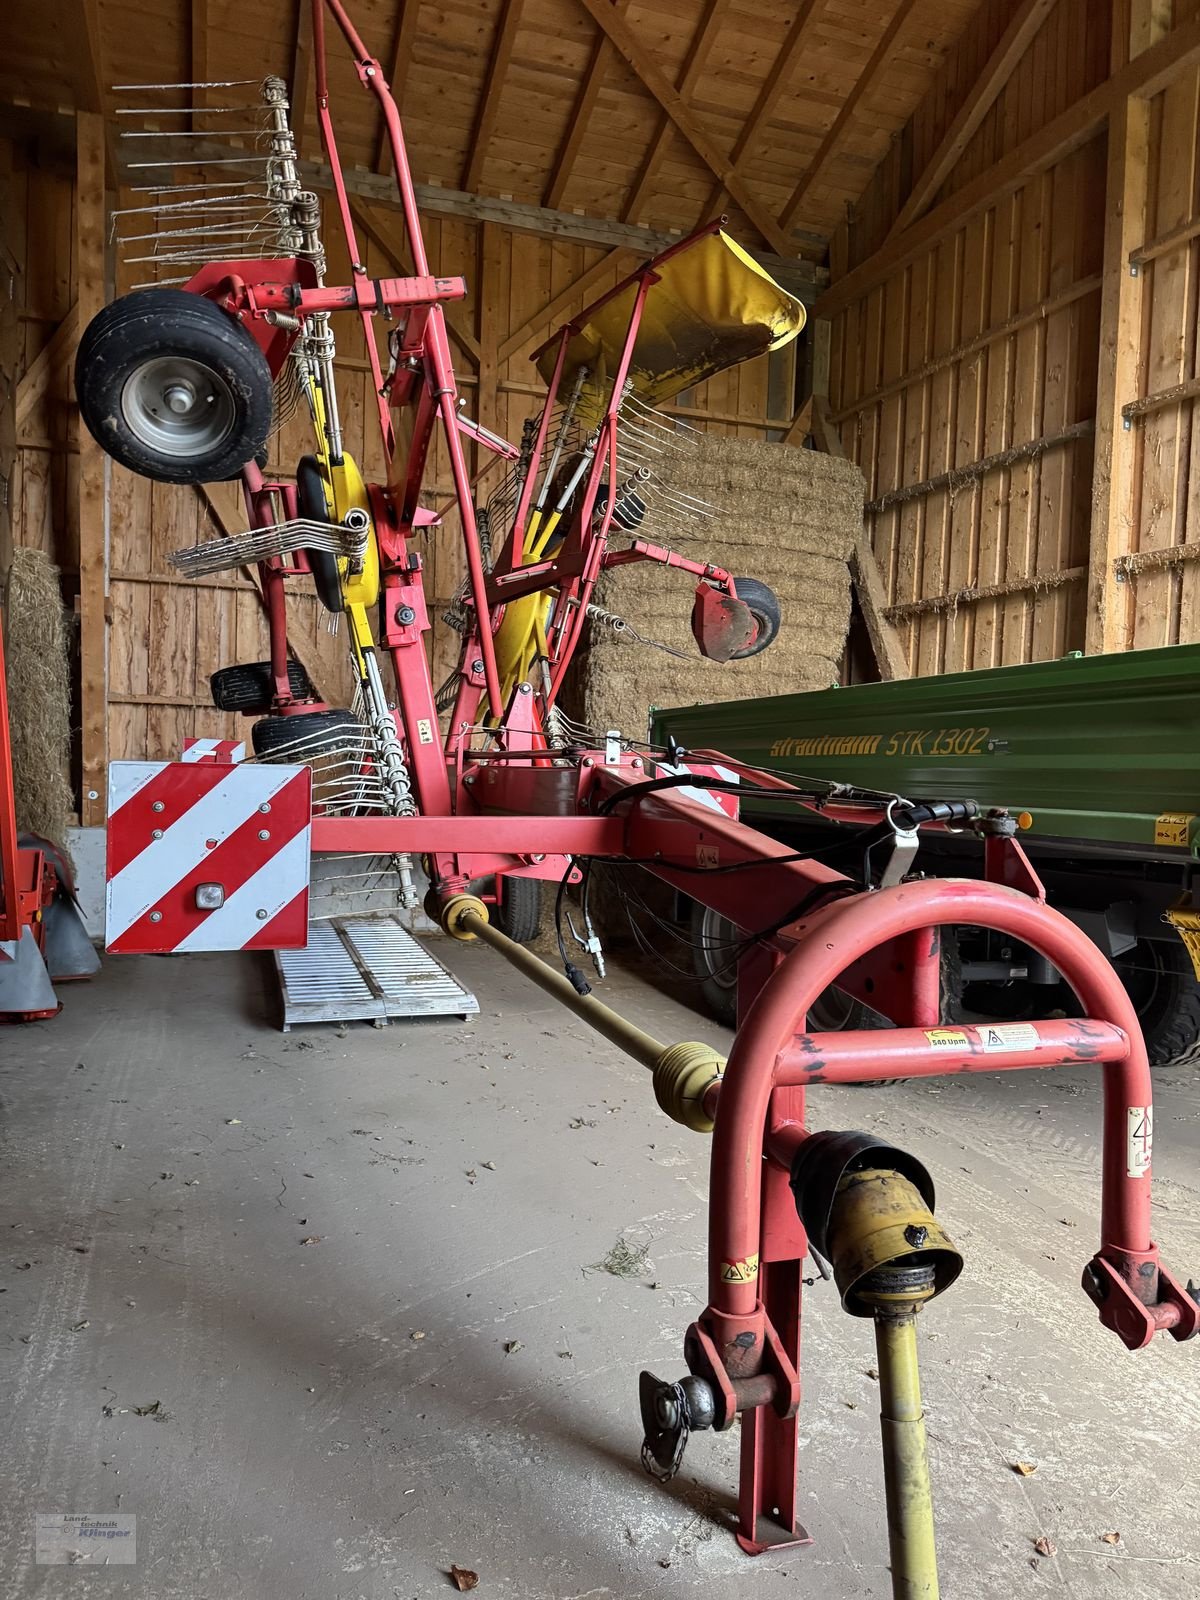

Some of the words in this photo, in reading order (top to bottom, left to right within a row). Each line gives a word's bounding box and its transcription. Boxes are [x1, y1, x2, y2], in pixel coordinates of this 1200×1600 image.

[770, 735, 883, 757] strautmann
[885, 730, 933, 755] STK
[929, 727, 990, 755] 1302
